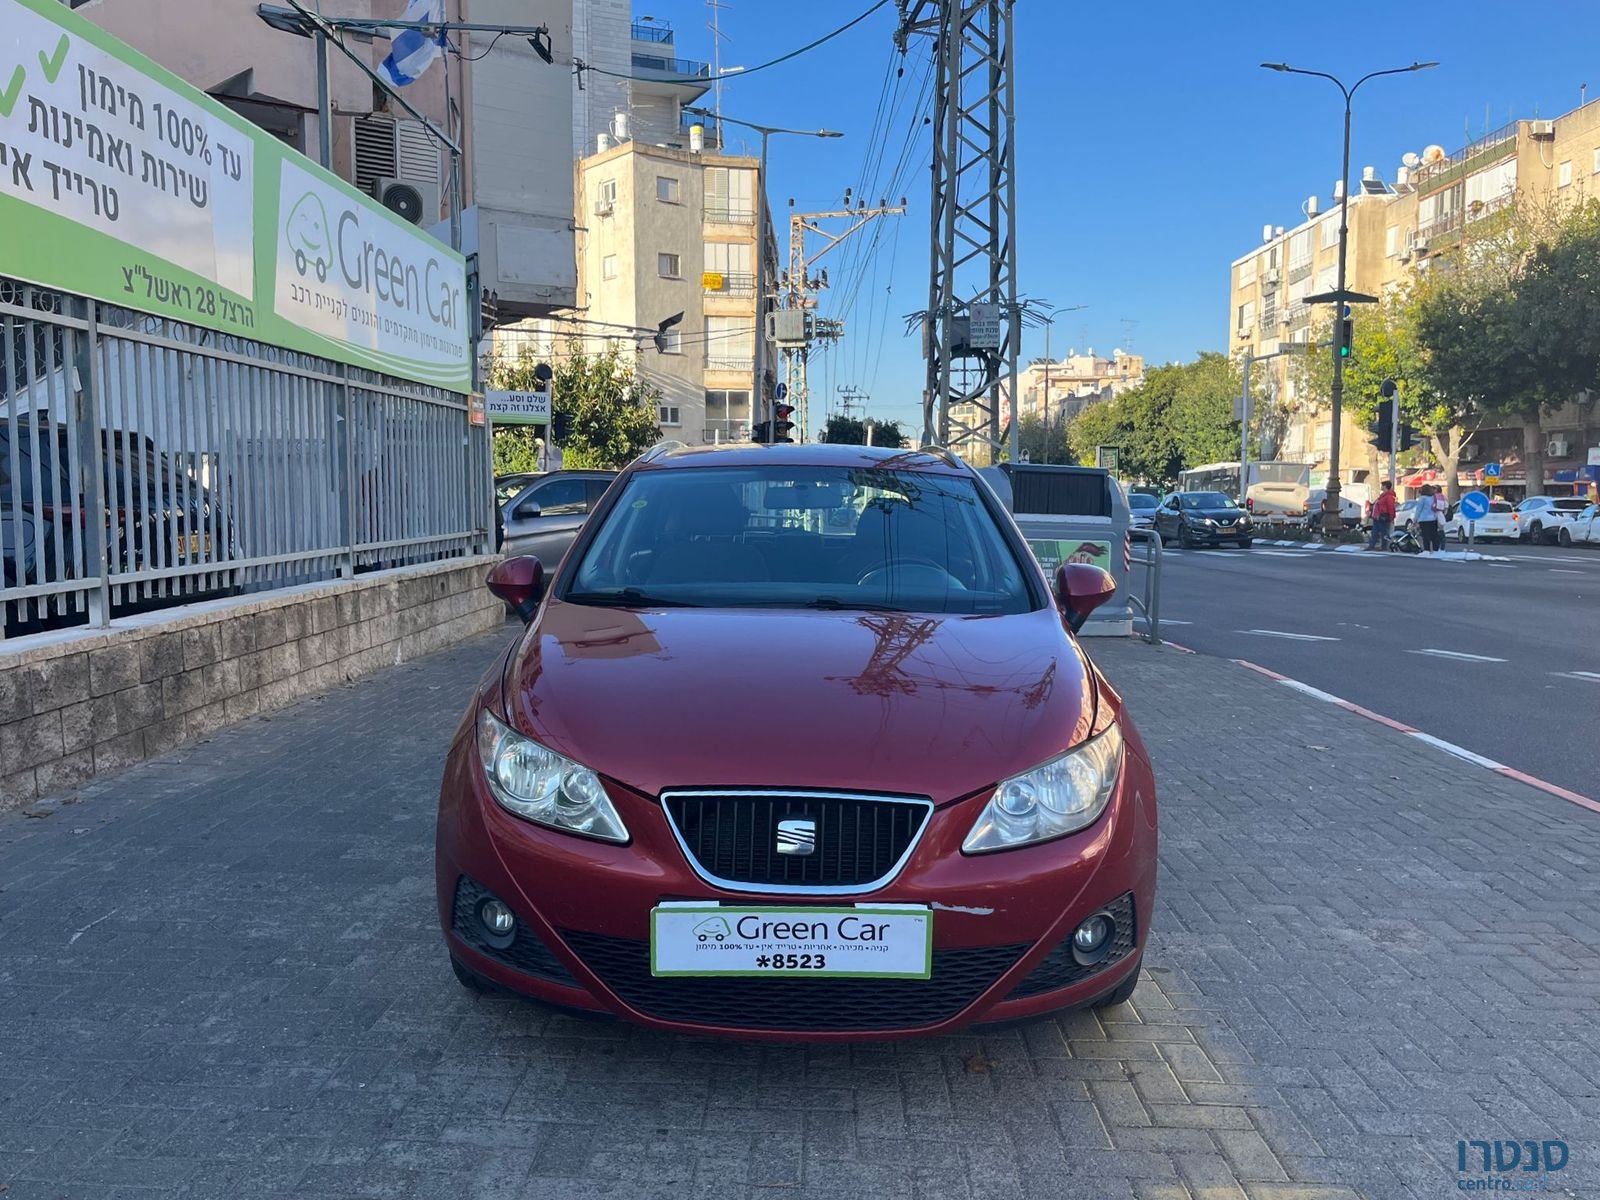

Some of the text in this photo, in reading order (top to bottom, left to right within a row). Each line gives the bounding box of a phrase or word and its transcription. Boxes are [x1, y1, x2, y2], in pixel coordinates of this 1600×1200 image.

[78, 63, 242, 181] עד 100% מימון
[28, 94, 207, 208] שירות ואמינות
[43, 160, 119, 221] טרייד
[338, 210, 459, 330] Green Car
[122, 264, 254, 328] הרצל 28 ראשל"צ
[291, 283, 312, 306] רכב
[315, 292, 348, 320] לקניית
[352, 303, 382, 330] והוגנים
[489, 403, 508, 413] קצת
[522, 403, 546, 412] אצלנו
[527, 394, 546, 404] שלם
[736, 916, 890, 941] Green Car
[696, 943, 717, 952] מימון
[761, 943, 773, 952] אין
[803, 943, 832, 951] אחריות
[871, 944, 889, 953] קניה
